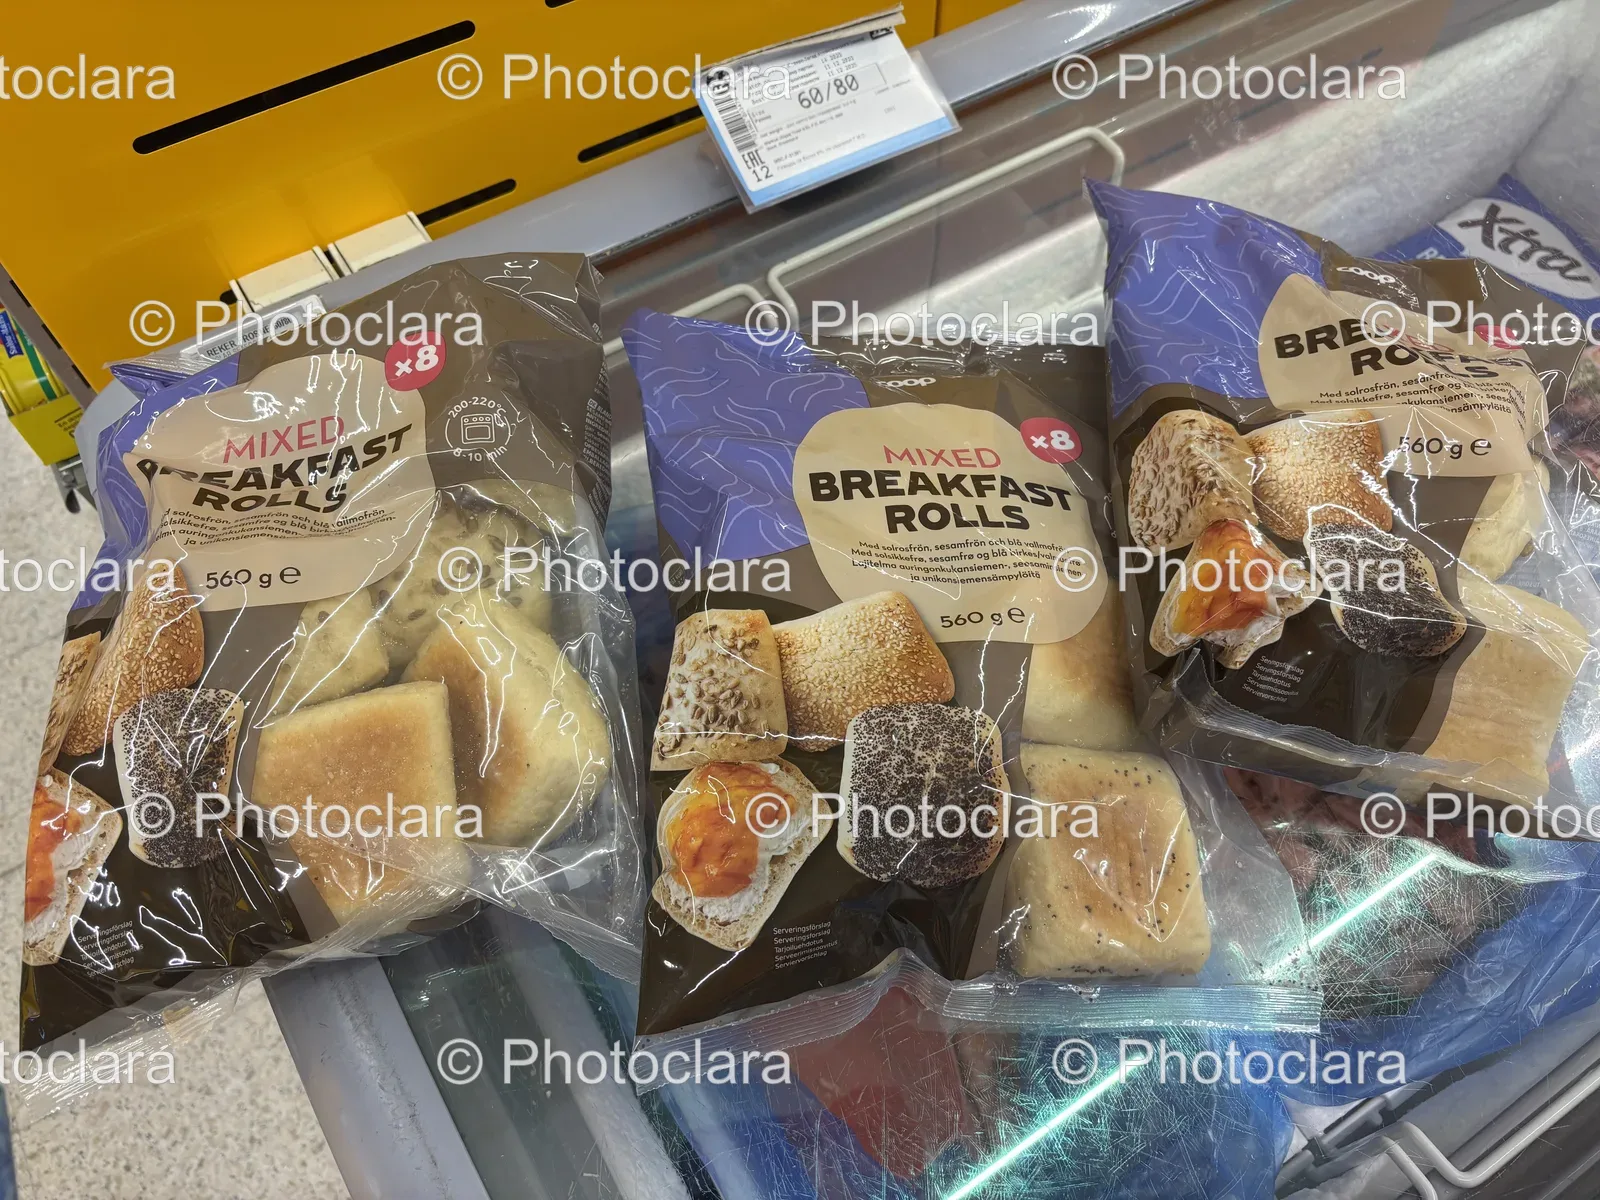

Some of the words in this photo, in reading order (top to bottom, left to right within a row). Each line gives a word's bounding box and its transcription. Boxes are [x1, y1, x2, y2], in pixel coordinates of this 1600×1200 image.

[798, 74, 859, 109] 60/80
[752, 166, 774, 183] 12
[1458, 202, 1592, 284] Xtra
[1336, 266, 1396, 284] coop
[206, 340, 237, 357] REKER
[1344, 382, 1399, 396] solrosfrön,
[1396, 385, 1445, 398] sesamfrø
[1448, 382, 1462, 390] og
[223, 415, 345, 463] MIXED
[882, 444, 1001, 469] MIXED
[1398, 436, 1443, 454] 560
[1450, 444, 1463, 460] g
[192, 483, 347, 514] ROLLS
[808, 469, 1073, 511] BREAKFAST
[172, 509, 231, 525] solrosfrön,
[292, 511, 311, 524] och
[313, 518, 330, 530] blå
[273, 519, 288, 527] og
[884, 502, 1030, 534] ROLLS
[183, 537, 197, 546] ja
[859, 541, 879, 550] Med
[881, 543, 932, 552] solrosfrön,
[934, 539, 986, 551] sesamfrön
[988, 537, 1006, 546] och
[1007, 538, 1022, 546] blå
[1023, 540, 1070, 554] vallmofrö
[851, 548, 872, 557] Med
[874, 552, 927, 563] solsikkefrø,
[928, 551, 974, 563] sesamfrø
[977, 553, 990, 561] og
[992, 548, 1008, 558] blå
[206, 568, 251, 589] 560
[259, 573, 272, 589] g
[909, 573, 920, 583] ja
[940, 611, 984, 628] 560
[990, 612, 1003, 626] g
[773, 921, 831, 935] Serveringsförslag
[773, 928, 831, 945] Serveringsforslag
